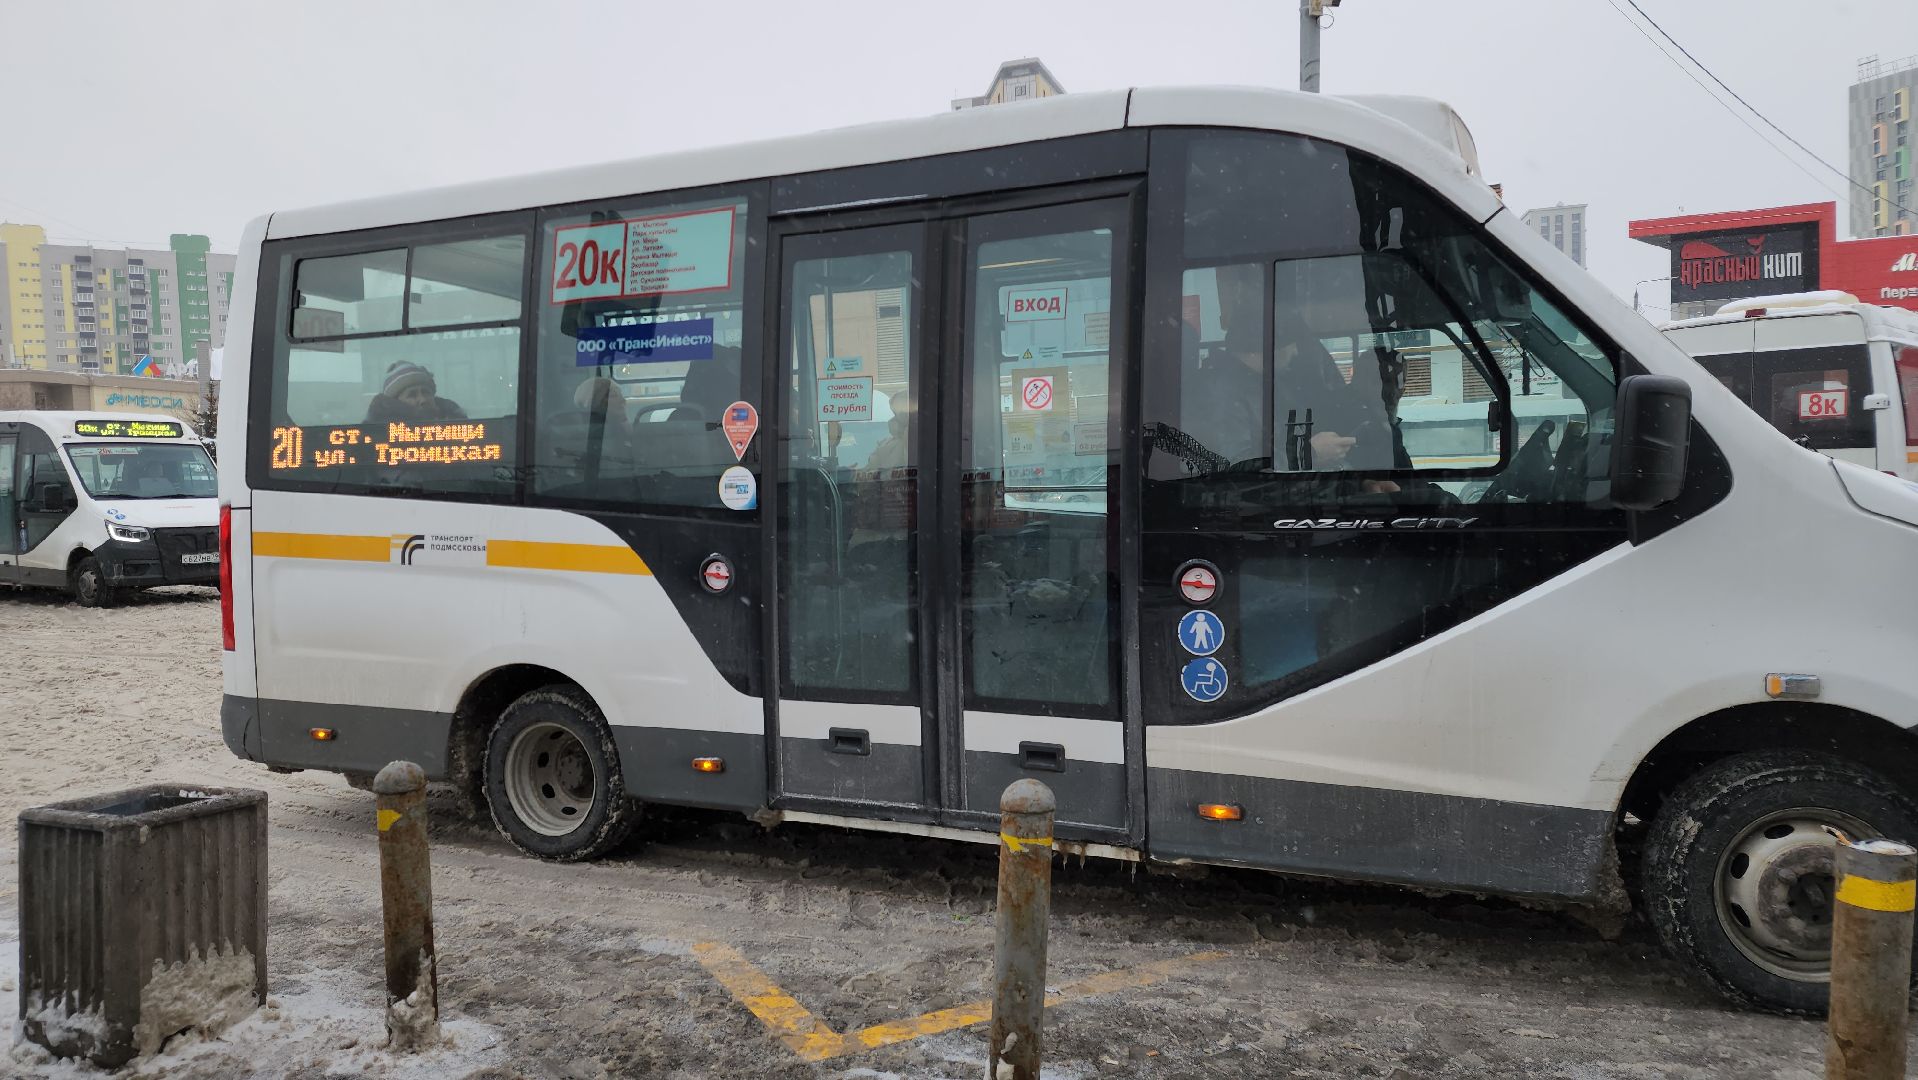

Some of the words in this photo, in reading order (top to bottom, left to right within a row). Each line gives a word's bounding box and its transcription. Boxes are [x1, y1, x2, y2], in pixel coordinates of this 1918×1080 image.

[1014, 297, 1061, 313] ВХОД
[577, 339, 606, 352] ООО
[609, 335, 712, 353] «ТрансИнвест»
[823, 404, 835, 414] 62
[838, 403, 867, 415] рубля
[329, 429, 372, 444] ст.
[389, 422, 484, 443] Мытищи
[315, 450, 356, 468] ул.
[375, 443, 500, 466] Троицкая
